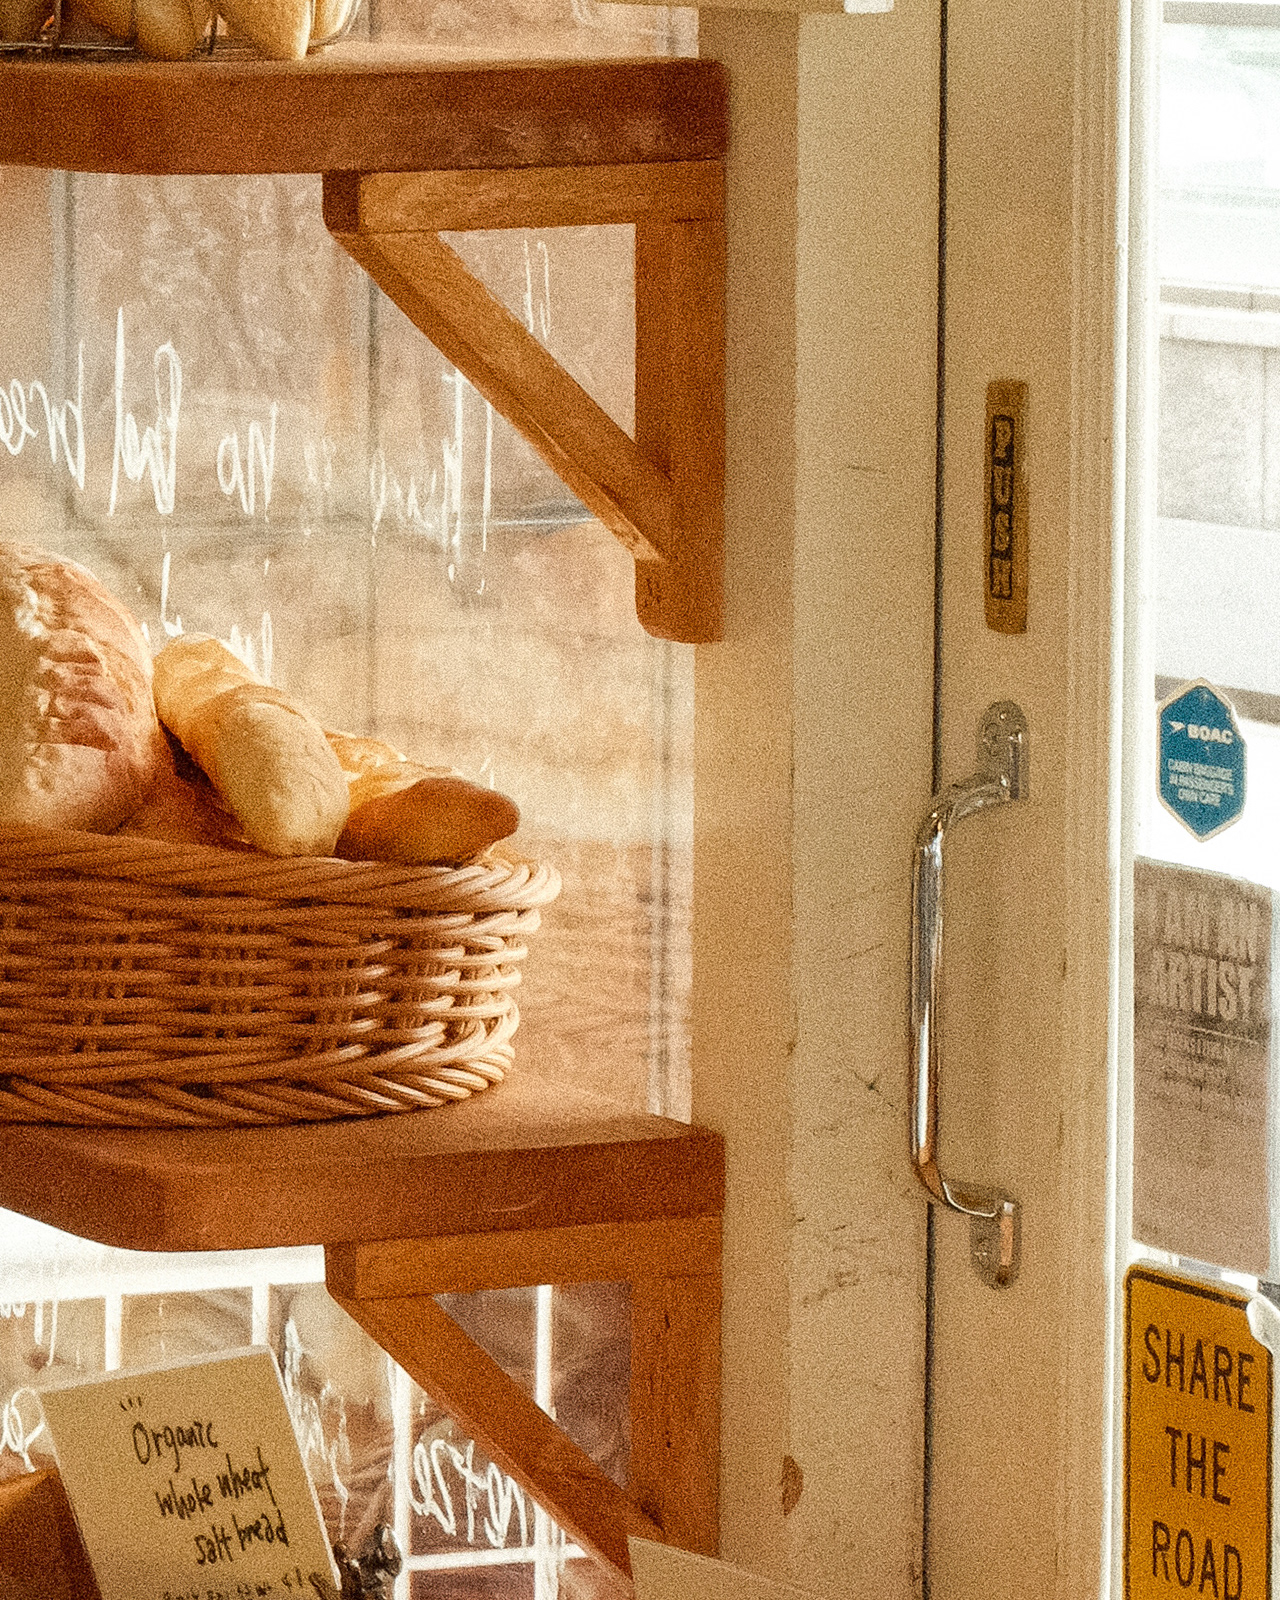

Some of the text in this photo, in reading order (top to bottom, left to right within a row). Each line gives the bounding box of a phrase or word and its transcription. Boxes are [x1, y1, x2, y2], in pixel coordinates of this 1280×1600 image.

[1187, 722, 1234, 746] BOAC
[1149, 949, 1256, 1023] ARTIST
[1142, 1323, 1256, 1414] SHARE
[131, 1419, 220, 1473] Organic
[155, 1444, 275, 1523] whole wheat
[1165, 1426, 1231, 1506] THE
